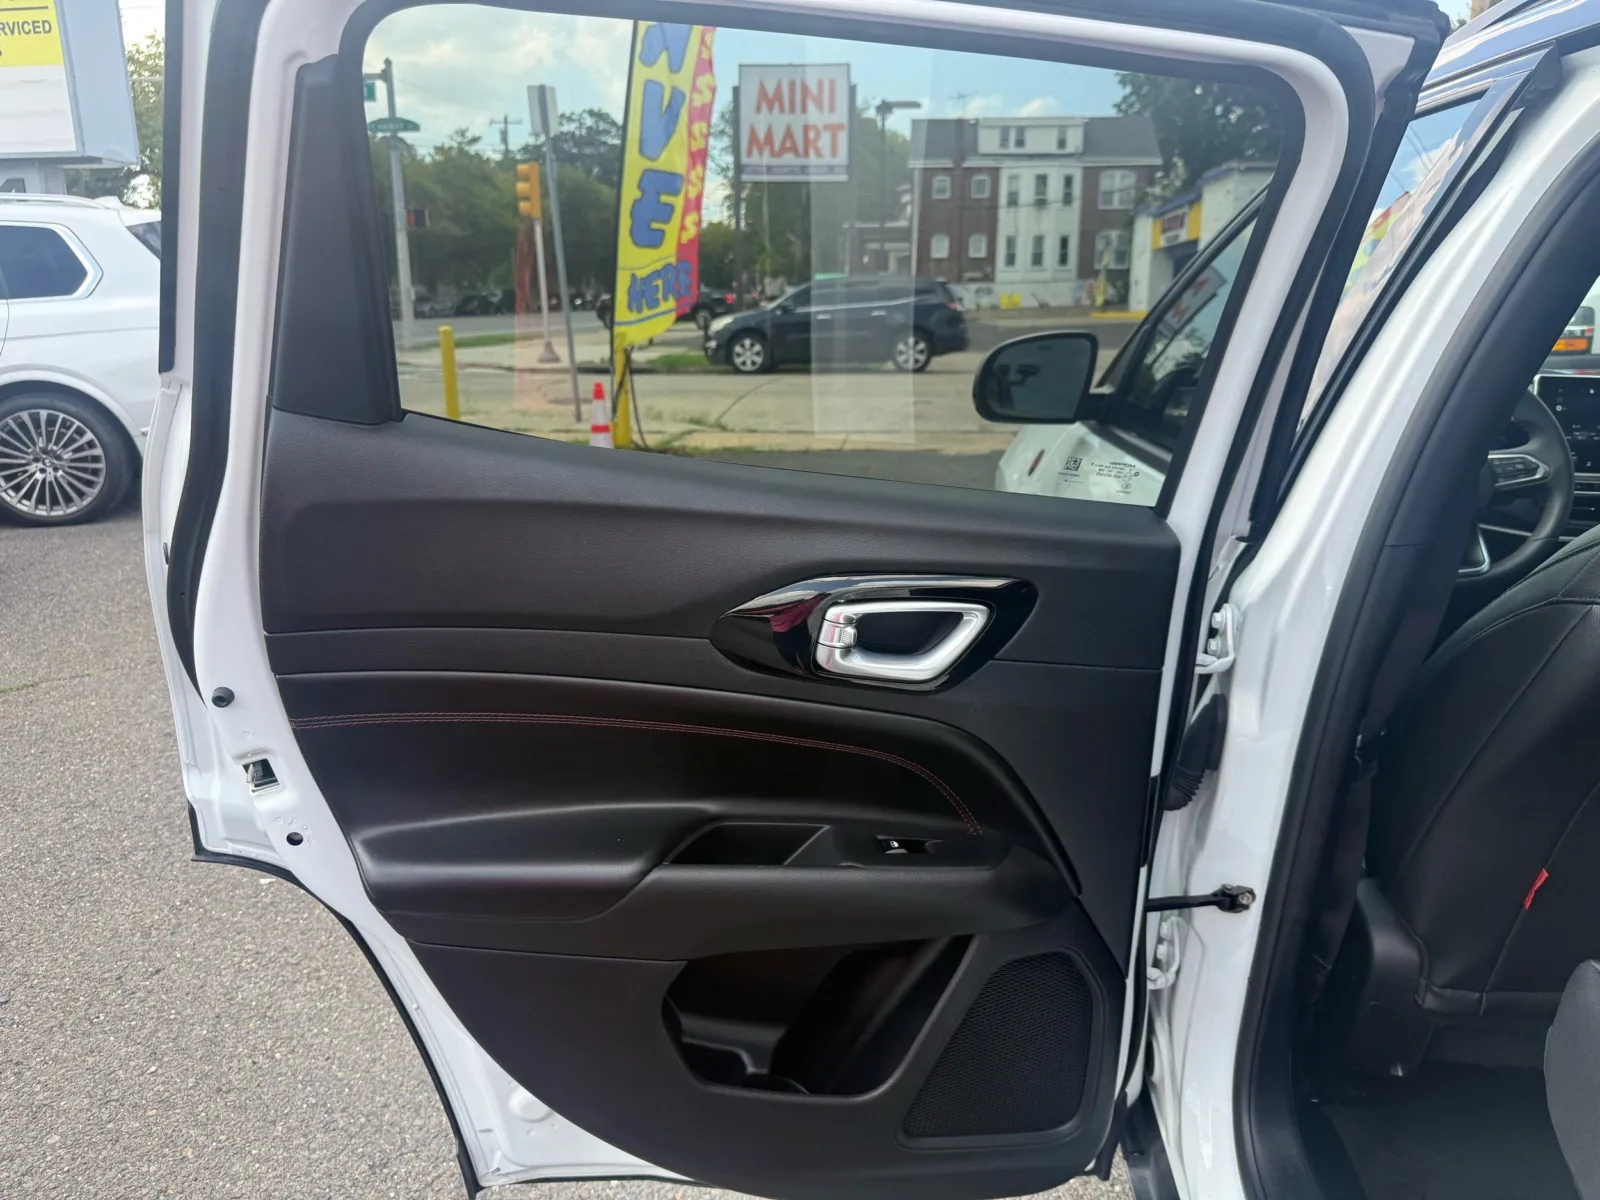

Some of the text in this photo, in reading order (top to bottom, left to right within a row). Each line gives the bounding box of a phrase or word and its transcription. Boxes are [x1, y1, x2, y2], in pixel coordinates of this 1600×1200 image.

[755, 78, 837, 115] MINI
[745, 123, 846, 159] MART
[627, 260, 693, 314] HERE
